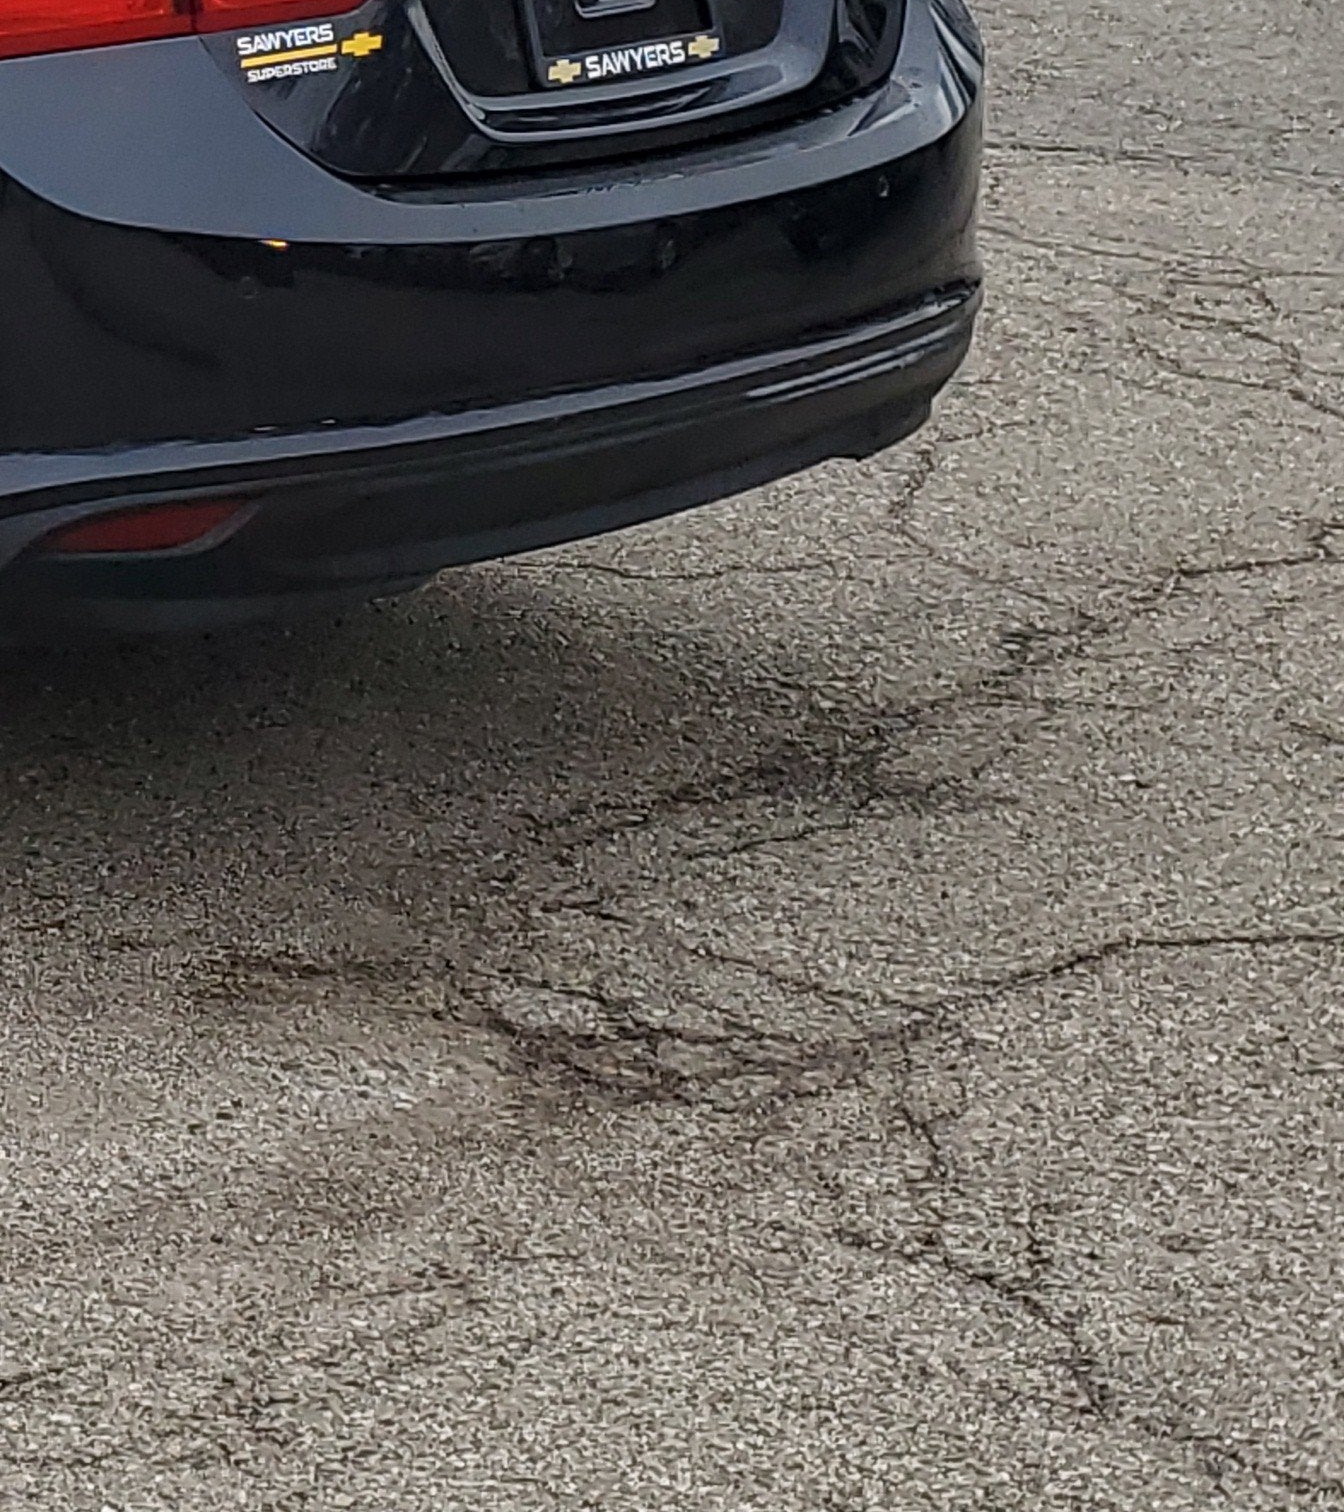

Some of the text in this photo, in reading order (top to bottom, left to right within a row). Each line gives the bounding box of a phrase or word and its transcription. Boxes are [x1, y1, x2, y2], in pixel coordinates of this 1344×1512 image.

[237, 23, 334, 55] SAWYERS
[247, 57, 338, 83] SUPERSTORE
[585, 40, 685, 79] SAWYERS
